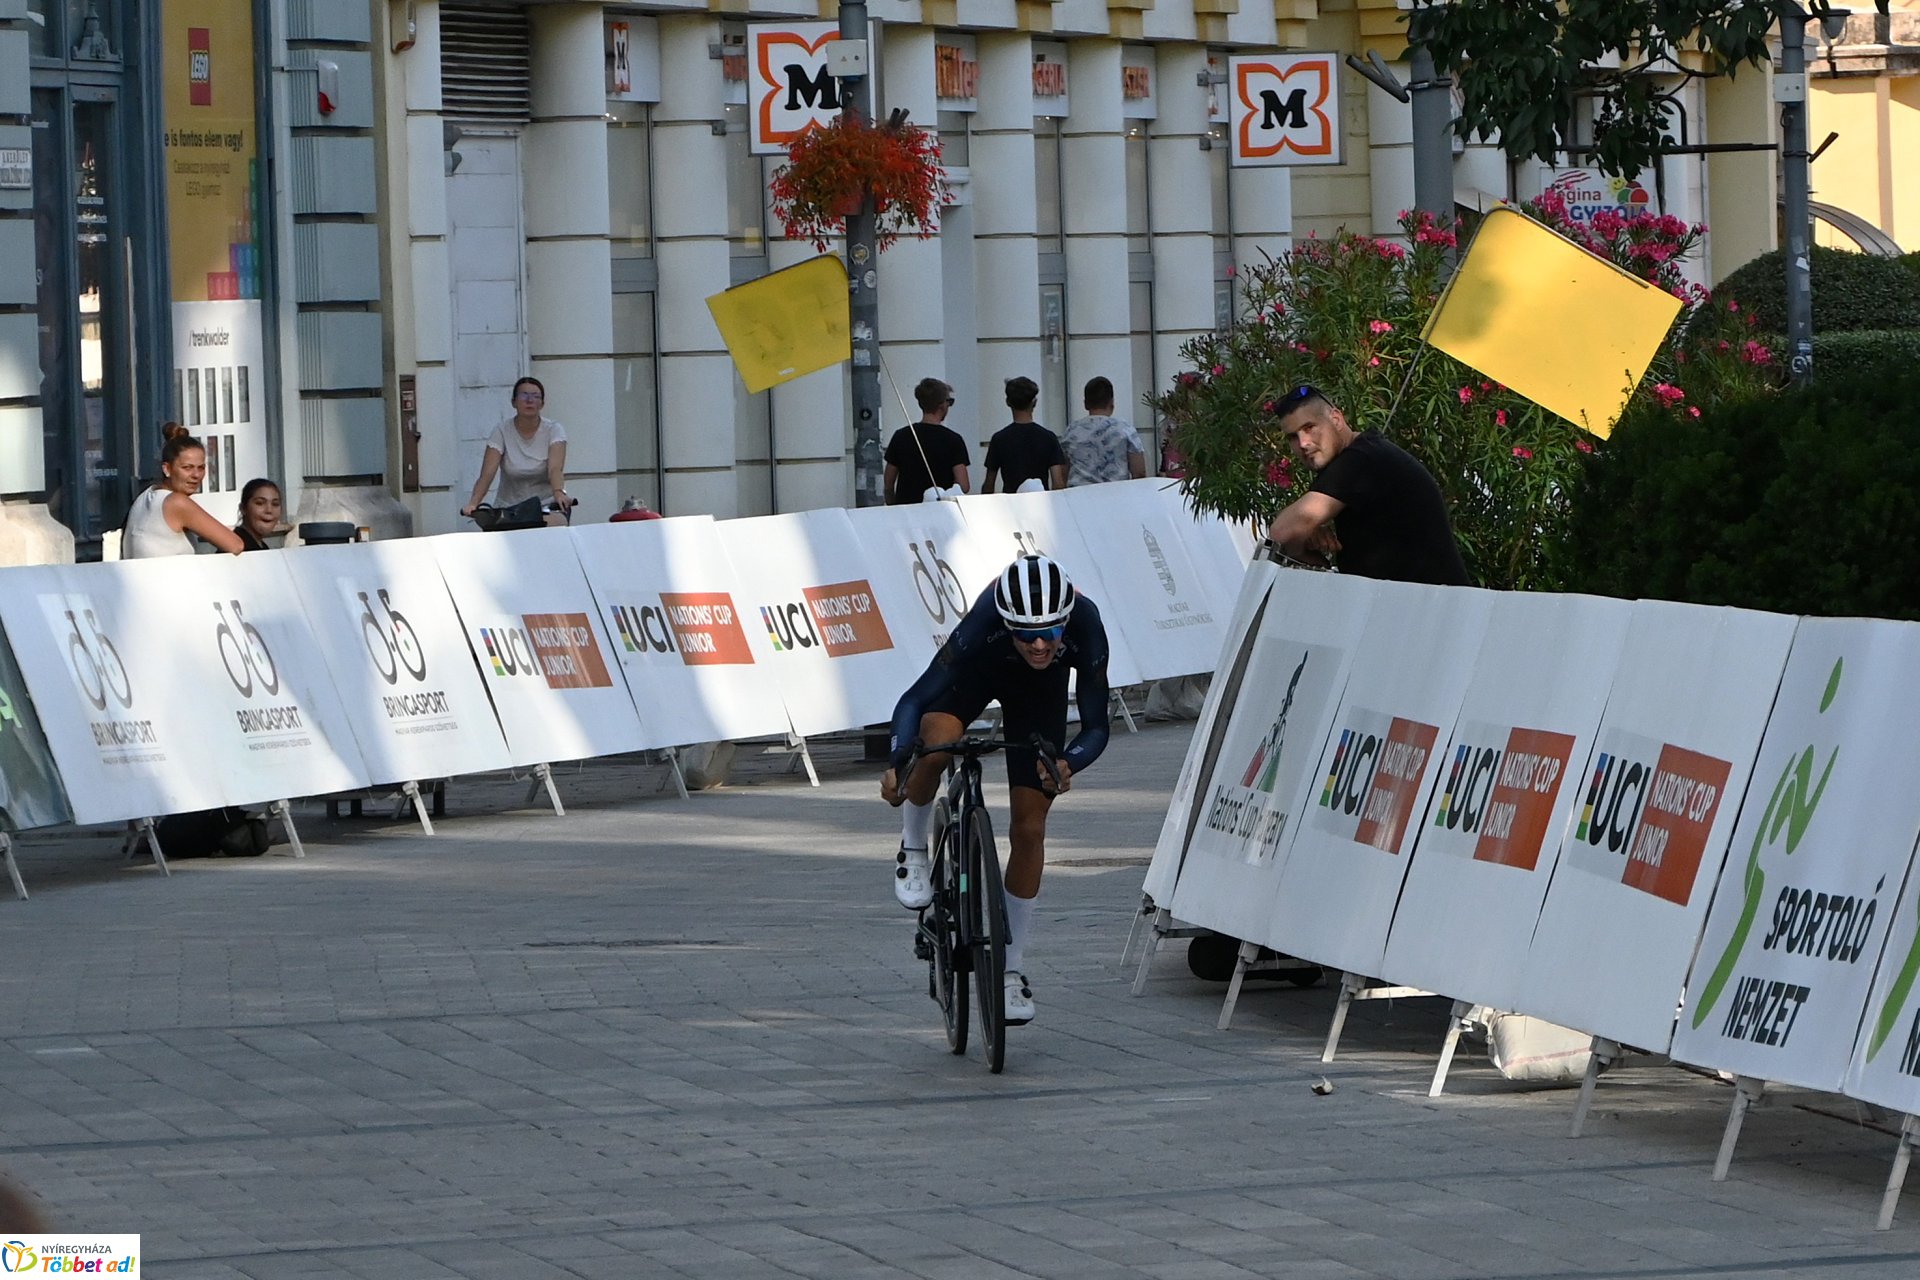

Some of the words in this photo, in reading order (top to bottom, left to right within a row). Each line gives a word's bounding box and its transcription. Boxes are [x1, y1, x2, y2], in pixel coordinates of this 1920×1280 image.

[191, 50, 209, 82] LEGO
[783, 63, 841, 110] M
[1259, 88, 1308, 130] M
[180, 129, 202, 147] fontos
[204, 129, 222, 147] elem
[224, 130, 243, 152] vagy!
[713, 605, 732, 625] CUP
[851, 592, 871, 613] CUP
[570, 626, 590, 647] CUP
[620, 605, 675, 653] UCI
[768, 602, 819, 650] UCI
[489, 628, 540, 676] UCI
[236, 706, 302, 733] BRINGASPORT
[383, 690, 449, 718] BRINGASPORT
[90, 720, 157, 746] BRINGASPORT
[1331, 731, 1383, 816] UCI
[1405, 746, 1426, 782] CUP
[1534, 756, 1561, 794] CUP
[1447, 745, 1501, 833] UCI
[1589, 755, 1651, 855] UCI
[1688, 779, 1717, 823] CUP
[1764, 872, 1887, 964] SPORTOLÓ
[1721, 975, 1811, 1048] NEMZET
